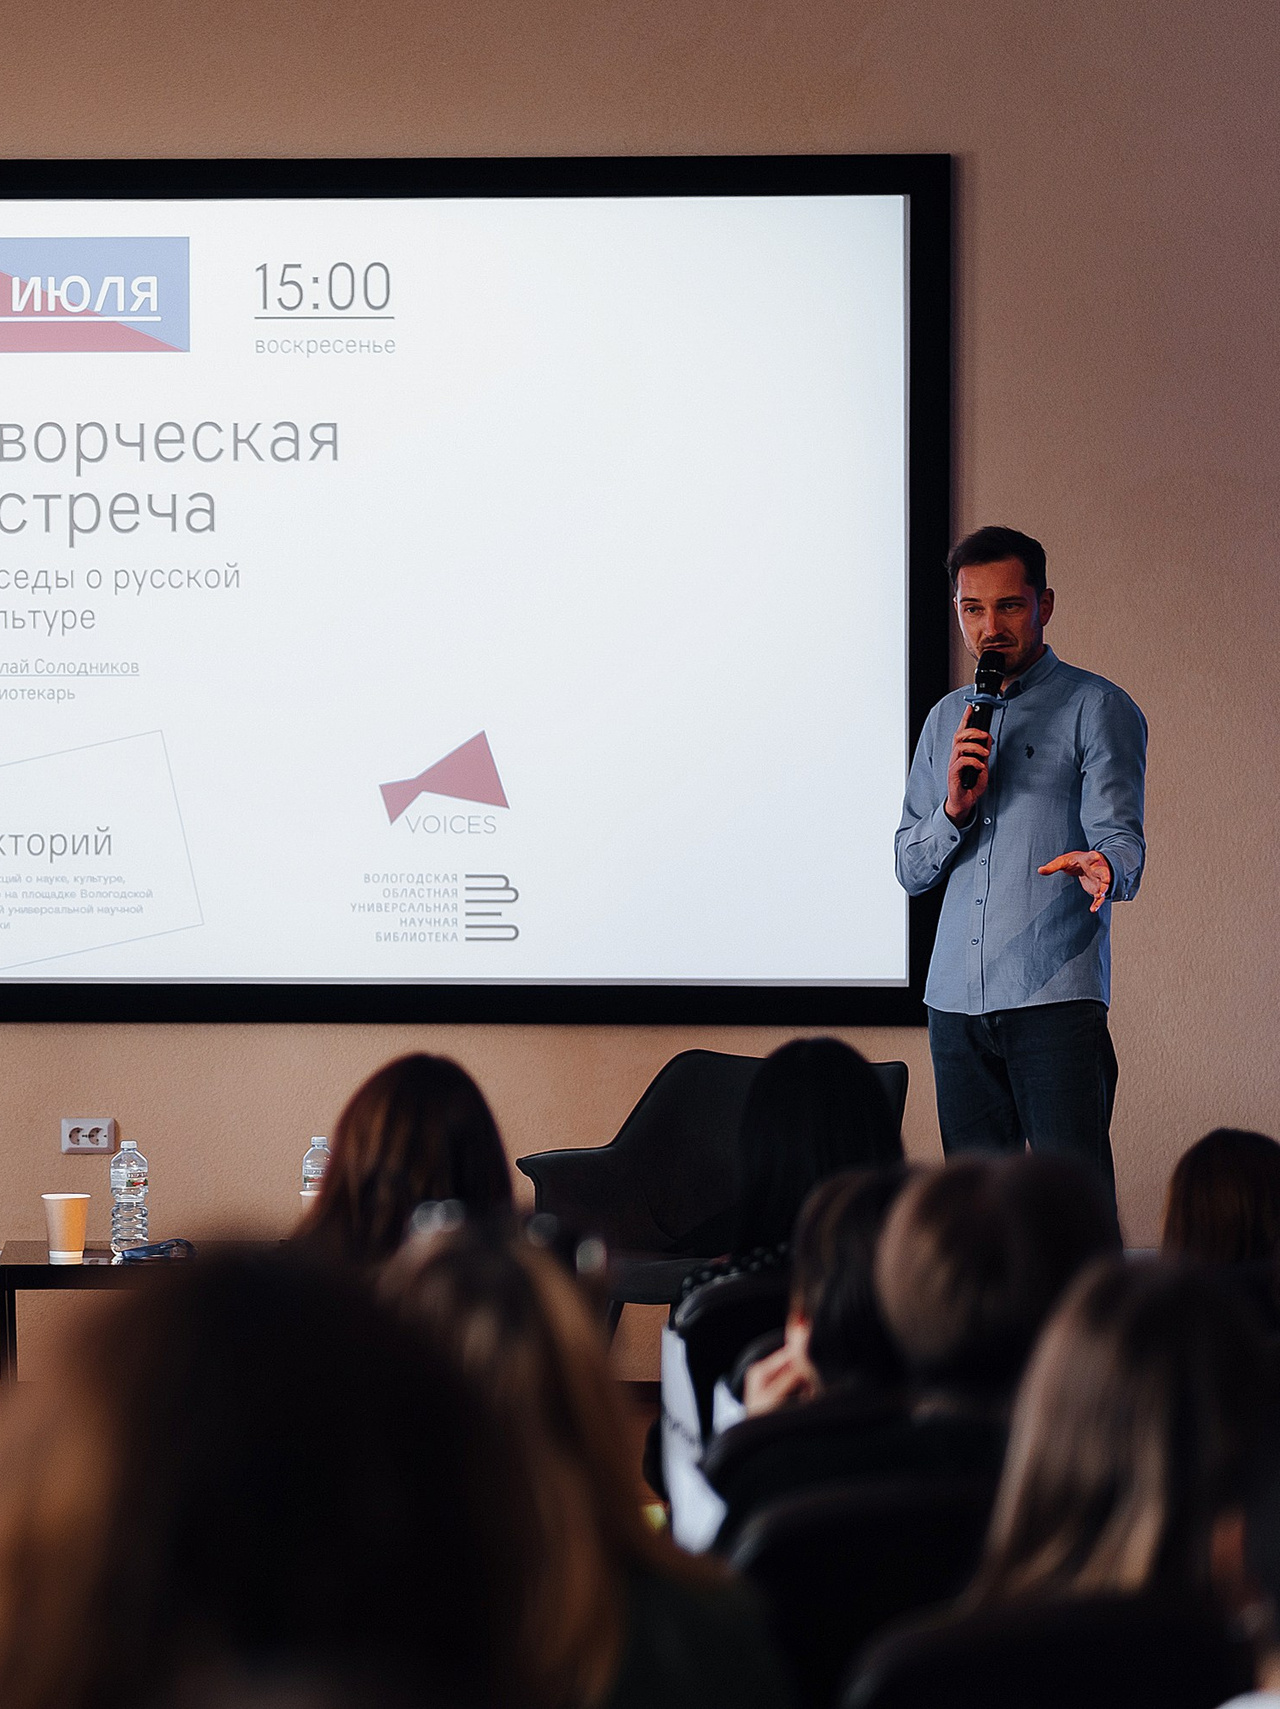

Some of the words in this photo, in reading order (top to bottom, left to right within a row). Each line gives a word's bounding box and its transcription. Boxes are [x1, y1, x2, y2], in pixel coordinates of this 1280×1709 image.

[254, 261, 391, 311] 15:00
[11, 274, 159, 313] июля
[255, 337, 396, 358] воскресенье
[86, 568, 103, 589] о
[114, 562, 240, 596] русской
[34, 659, 139, 676] Солодников
[404, 814, 497, 834] VOICES
[25, 875, 33, 884] о
[36, 874, 70, 886] науке,
[73, 874, 126, 886] культуре,
[363, 873, 459, 885] ВОЛОГОДСКАЯ
[5, 890, 18, 900] на
[21, 890, 77, 901] площадке
[80, 888, 154, 900] Вологодской
[382, 887, 459, 899] ОБЛАСТНАЯ
[8, 904, 94, 916] универсальной
[97, 904, 144, 916] научной
[350, 902, 459, 913] УНИВЕРСАЛЬНАЯ
[399, 917, 459, 928] НАУЧНАЯ
[375, 931, 459, 943] БИБЛИОТЕКА
